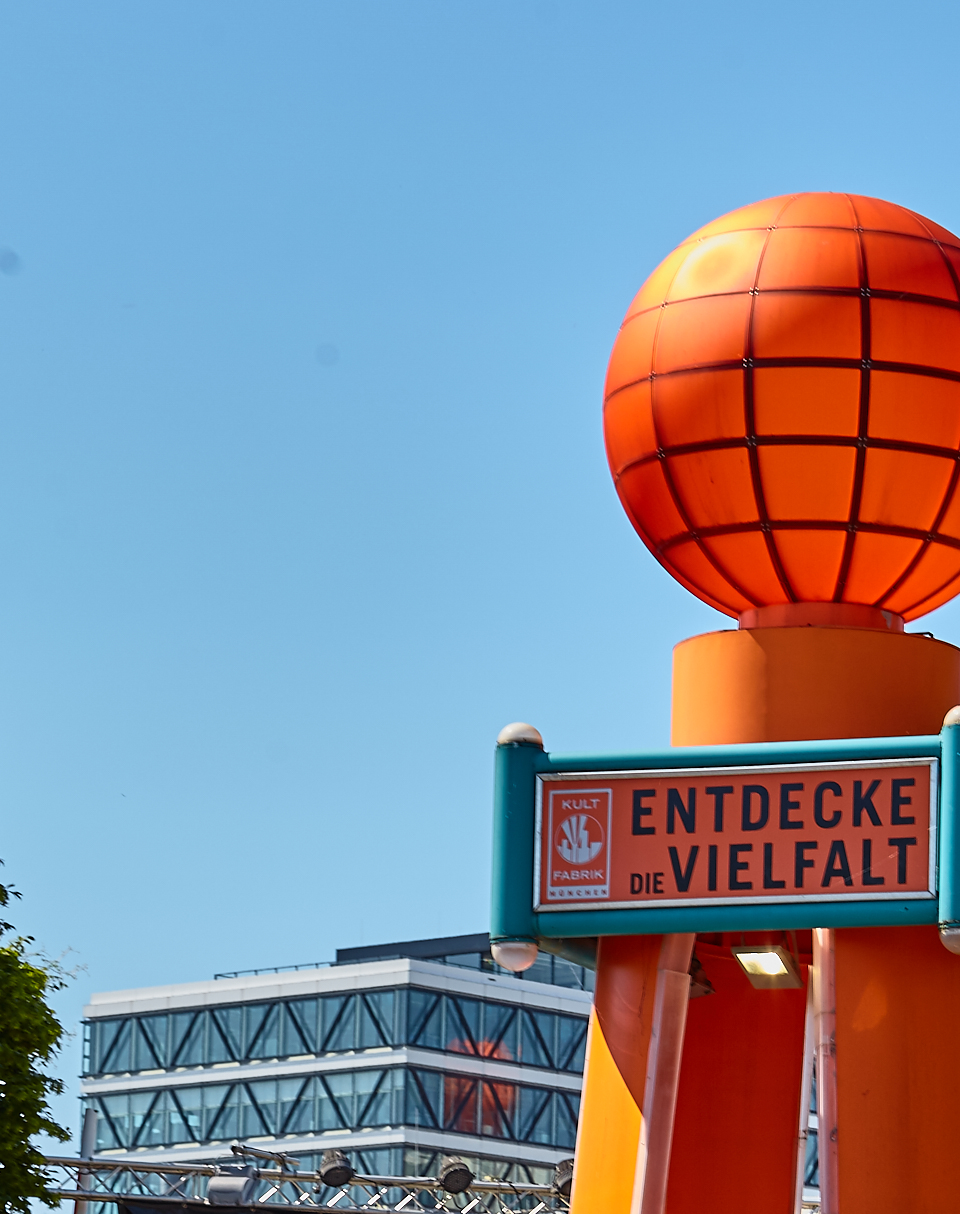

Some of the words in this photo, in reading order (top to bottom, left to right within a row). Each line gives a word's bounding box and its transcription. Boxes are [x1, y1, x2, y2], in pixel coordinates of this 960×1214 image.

[562, 798, 600, 810] KULT
[631, 778, 917, 836] ENTDECKE
[553, 869, 604, 880] FABRIK
[630, 872, 665, 895] DIE
[668, 837, 917, 893] VIELFALT
